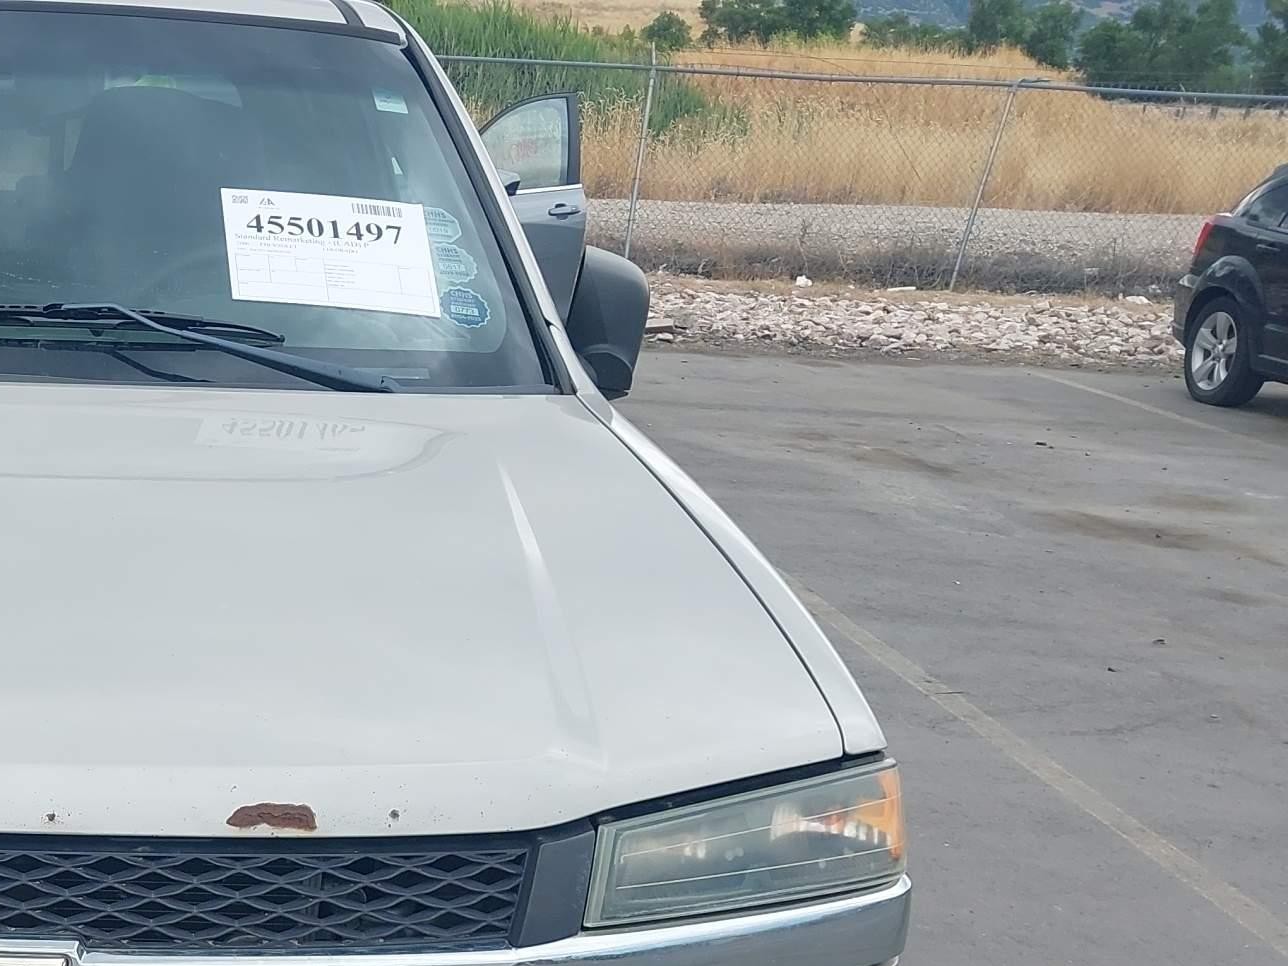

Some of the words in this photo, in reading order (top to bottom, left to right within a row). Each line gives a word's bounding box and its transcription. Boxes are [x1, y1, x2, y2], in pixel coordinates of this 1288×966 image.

[234, 233, 271, 241] Standard
[274, 234, 325, 246] Remarketing
[246, 213, 402, 245] 45501497
